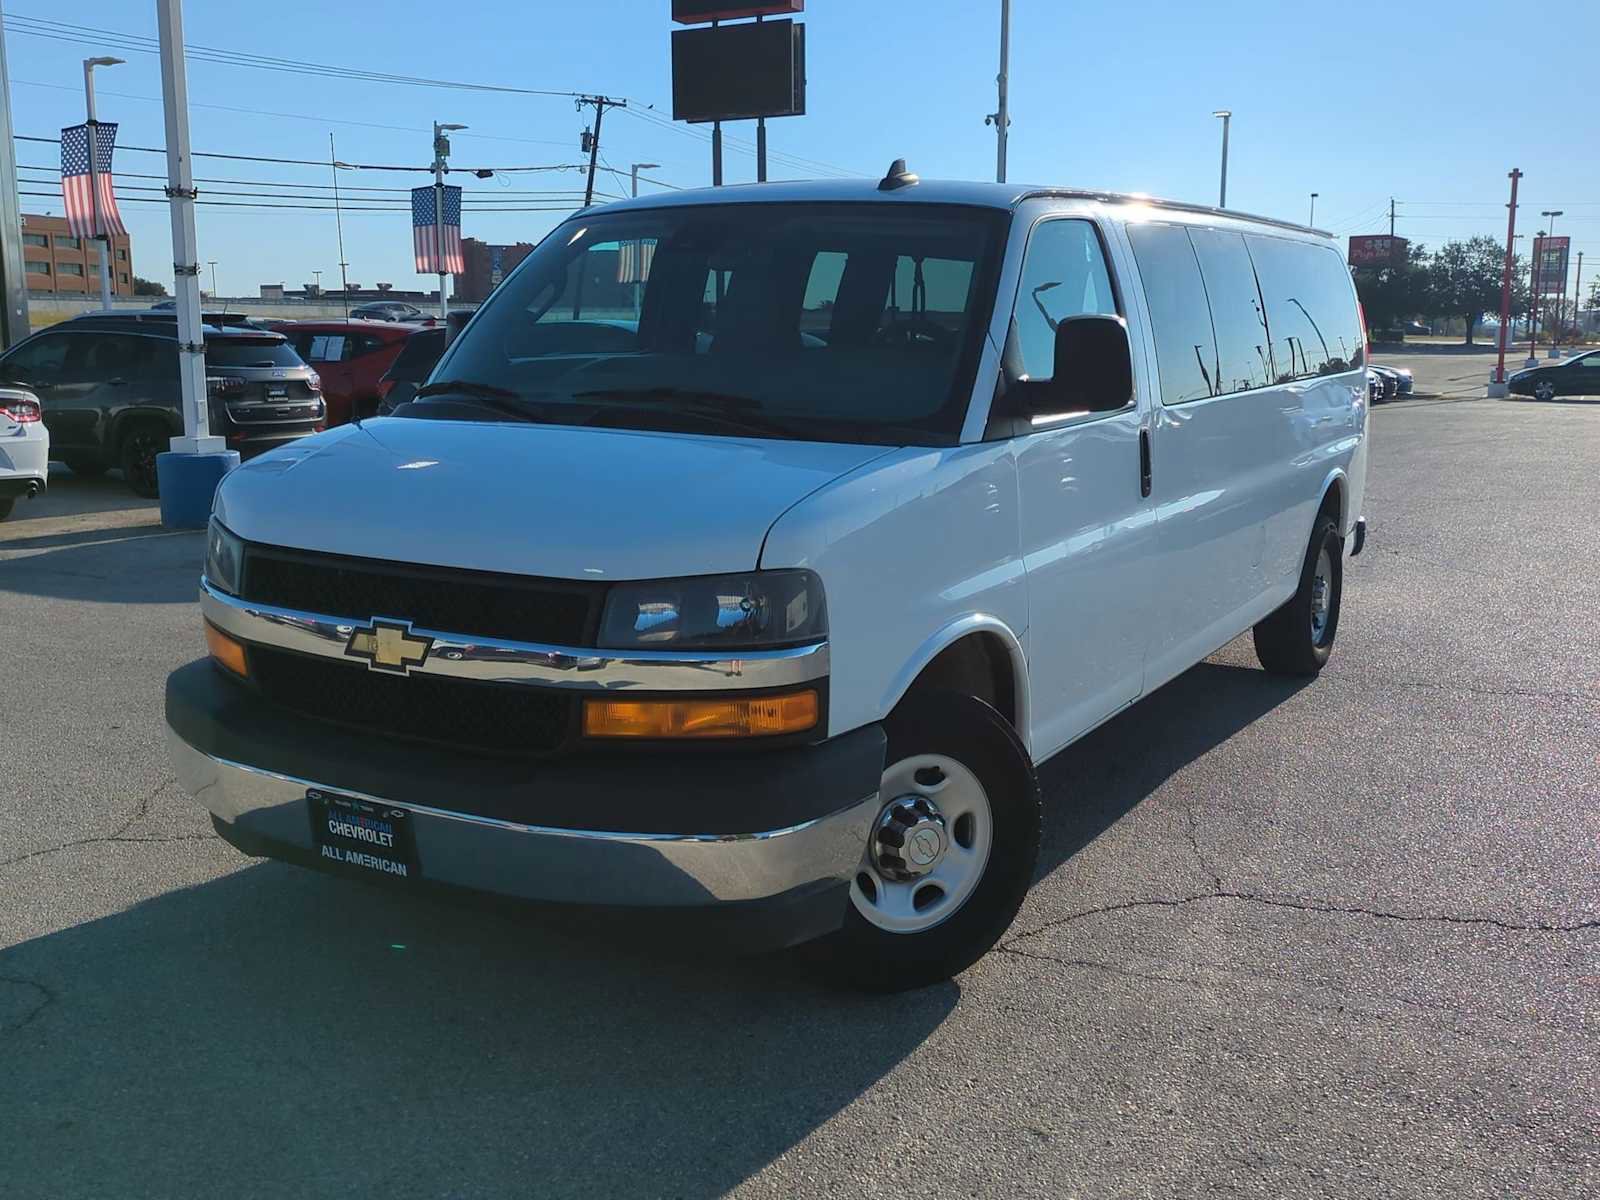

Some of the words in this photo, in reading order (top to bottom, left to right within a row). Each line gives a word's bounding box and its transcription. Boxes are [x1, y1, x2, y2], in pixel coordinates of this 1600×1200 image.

[328, 819, 393, 847] CHEVROLET
[321, 845, 343, 860] ALL
[345, 850, 407, 877] AMERICAN
